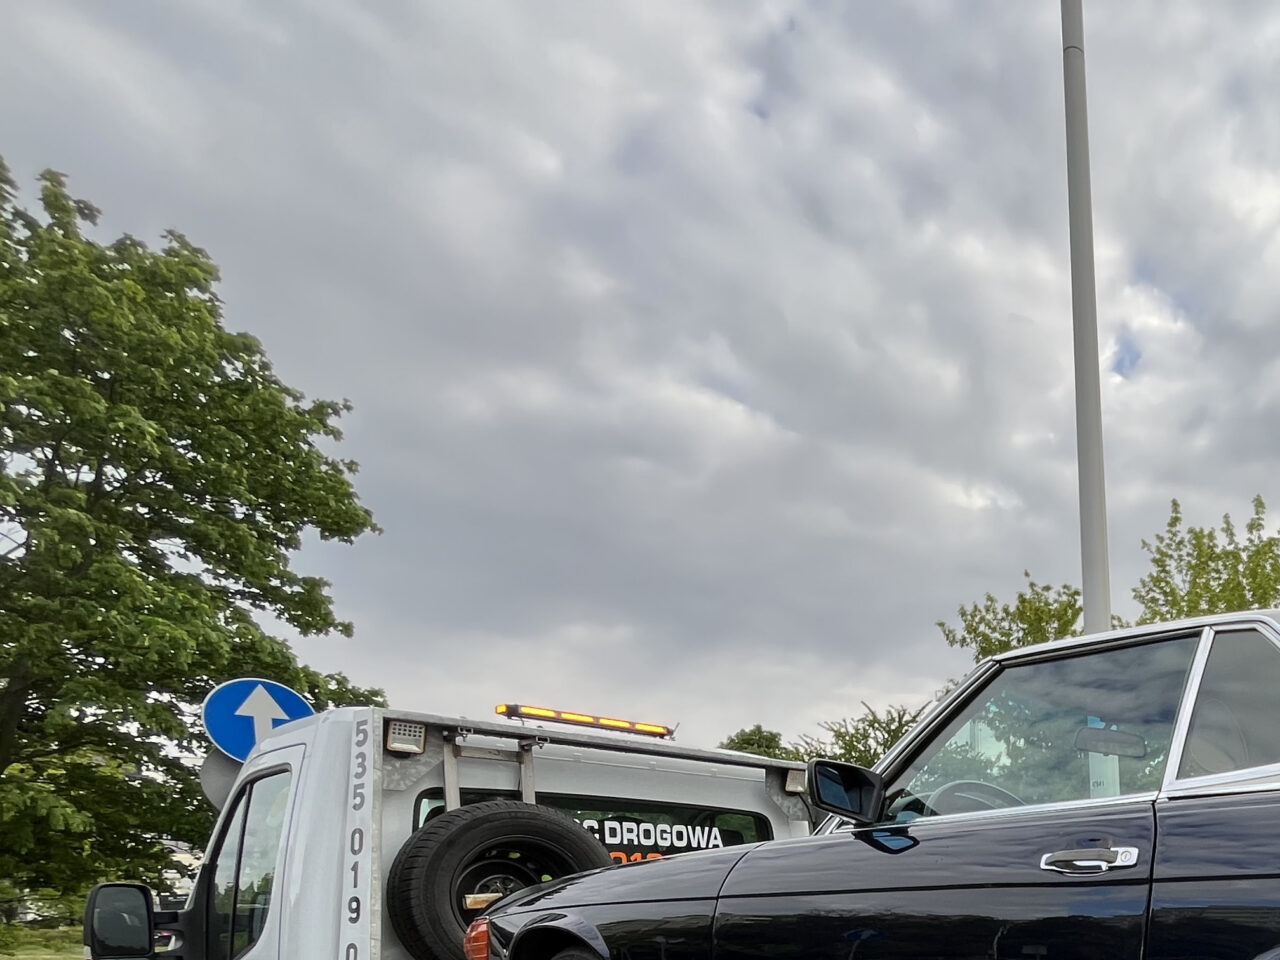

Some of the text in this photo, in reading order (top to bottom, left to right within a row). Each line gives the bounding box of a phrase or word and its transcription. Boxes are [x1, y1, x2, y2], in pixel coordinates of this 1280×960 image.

[352, 719, 368, 811] 535
[347, 828, 364, 924] 019
[603, 820, 724, 848] DROGOWA
